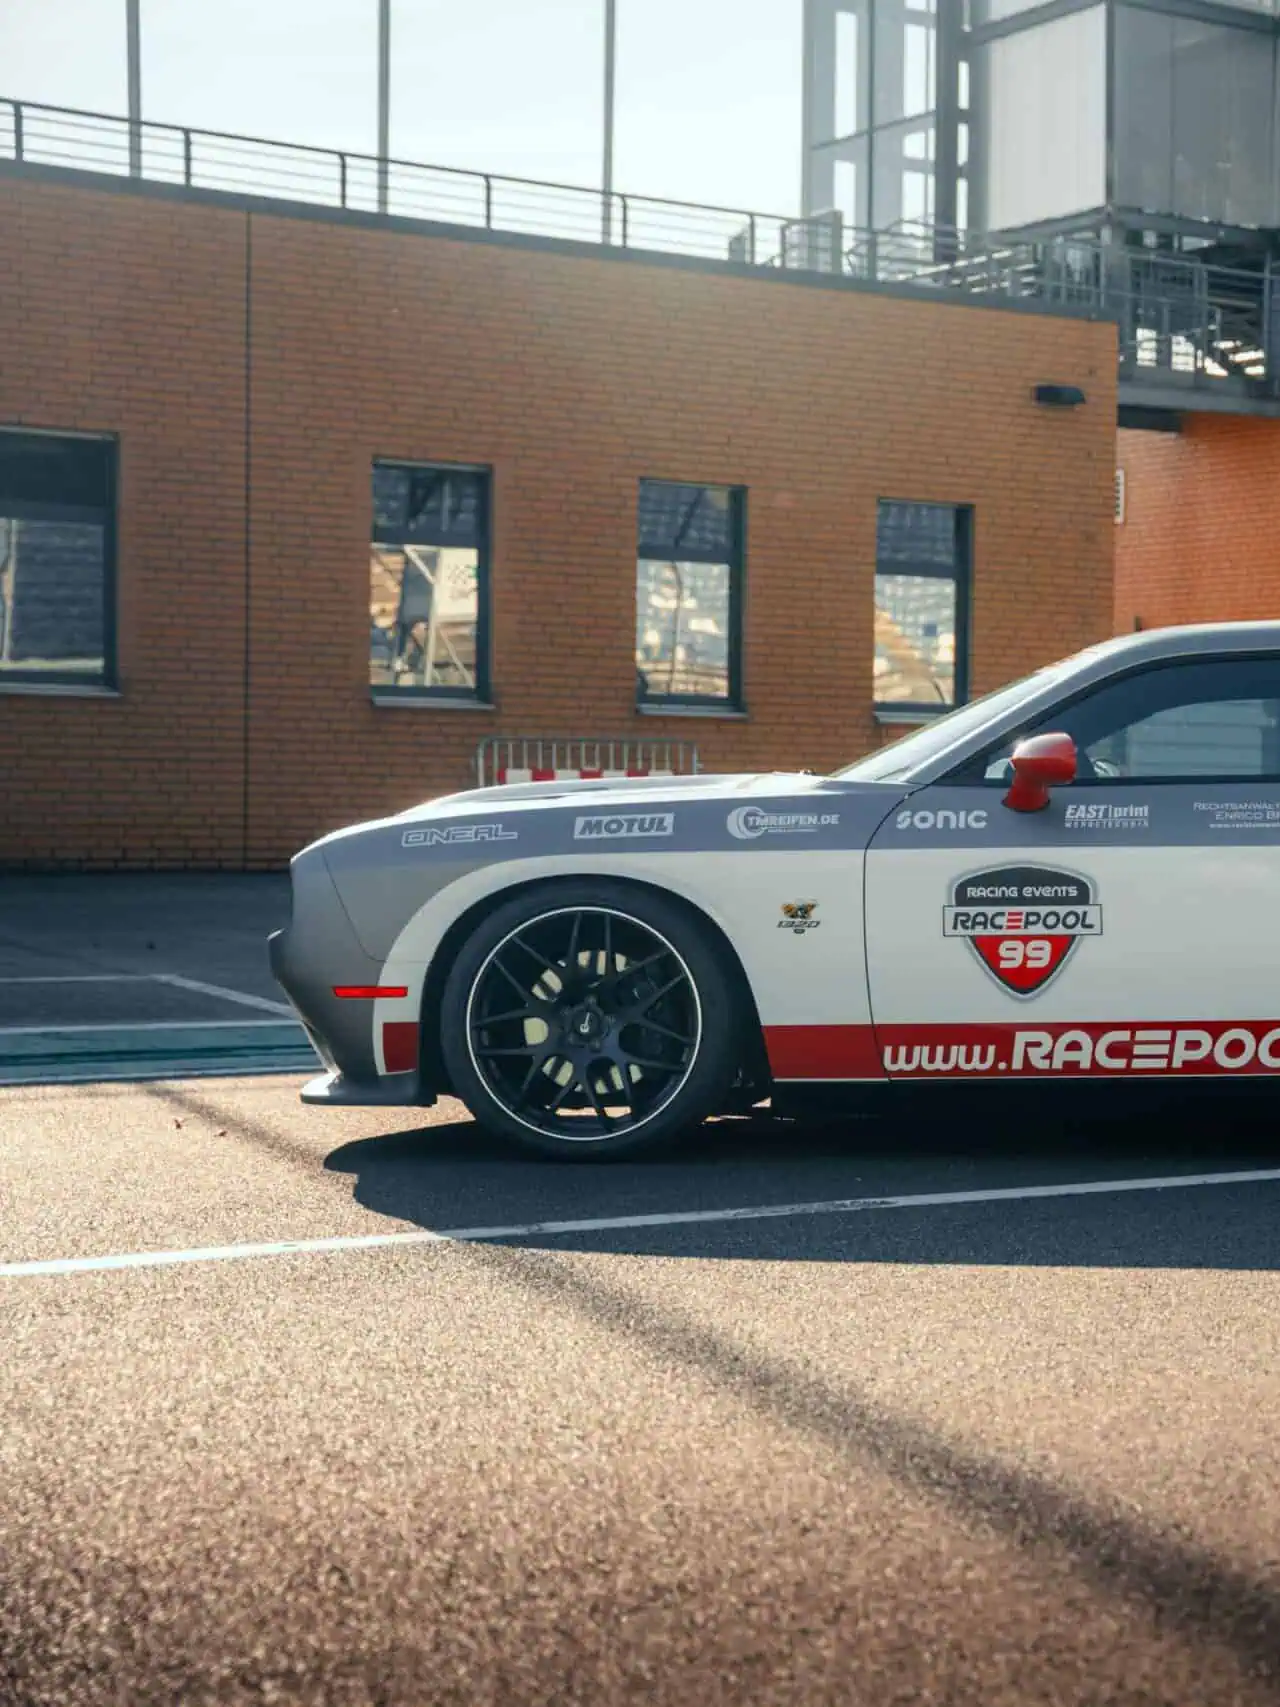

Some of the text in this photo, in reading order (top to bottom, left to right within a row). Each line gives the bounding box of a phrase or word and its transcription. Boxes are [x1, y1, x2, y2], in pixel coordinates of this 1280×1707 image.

[1065, 804, 1108, 819] EAST
[578, 816, 669, 835] MOTUL
[952, 911, 1095, 930] RACEPOOL
[998, 940, 1052, 969] 99
